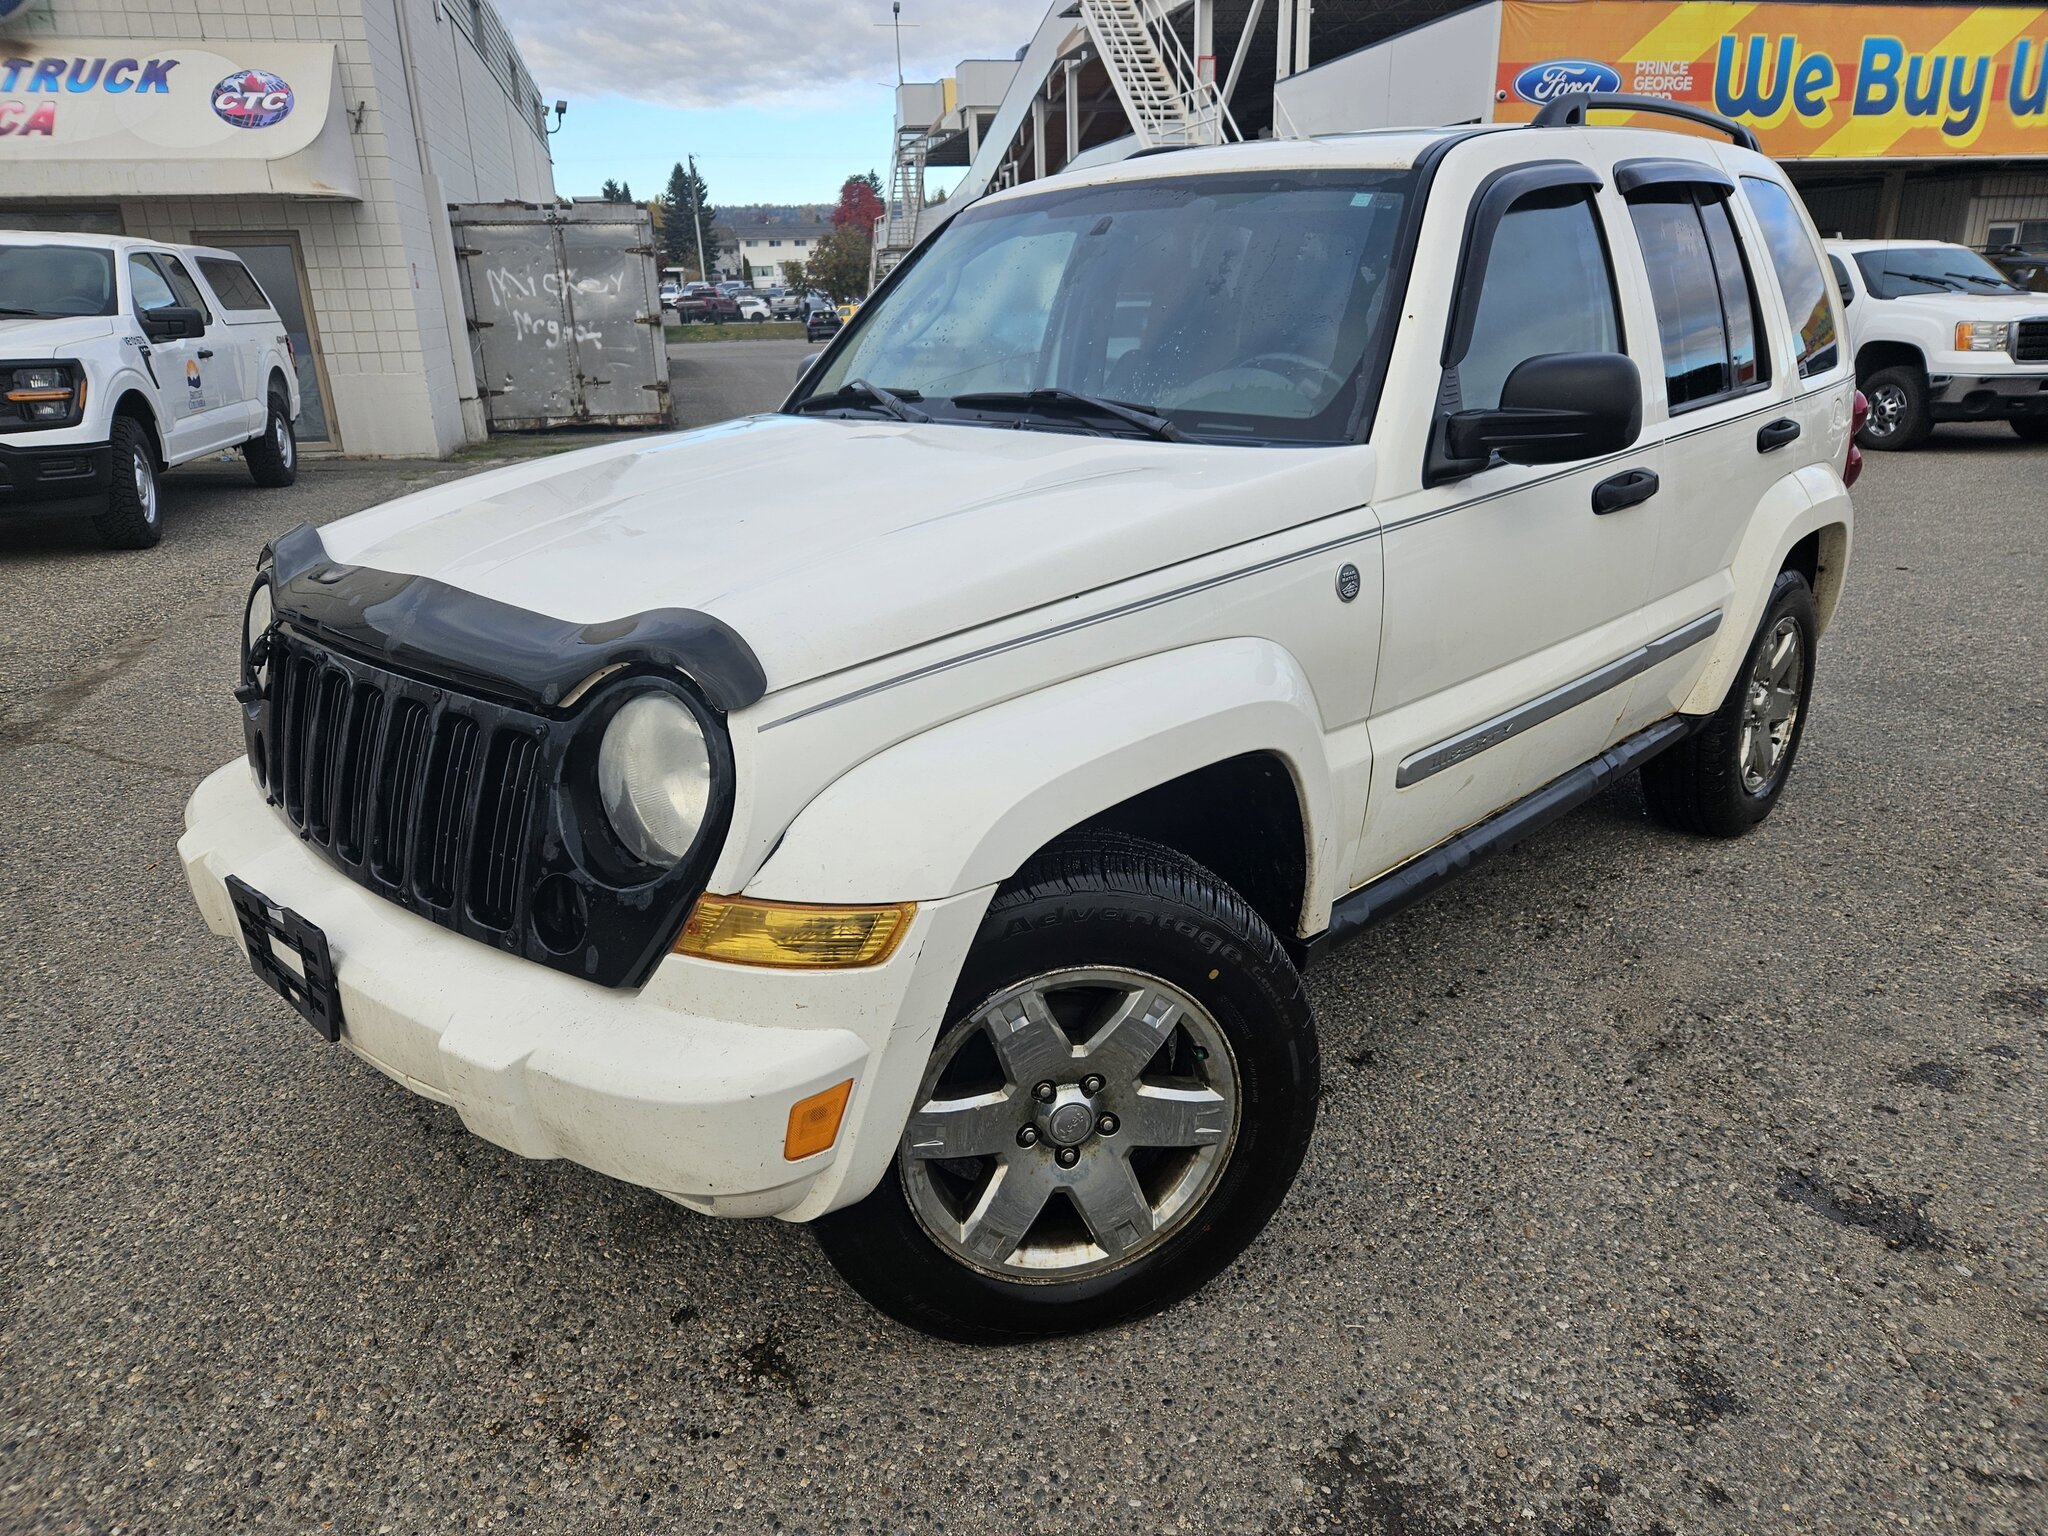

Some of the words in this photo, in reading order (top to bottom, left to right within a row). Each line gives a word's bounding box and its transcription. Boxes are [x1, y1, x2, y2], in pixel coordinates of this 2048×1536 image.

[1, 57, 180, 94] TRUCK
[1534, 66, 1602, 99] Ford
[1633, 76, 1694, 91] GEORGE
[1635, 60, 1690, 75] PRINCE
[214, 91, 288, 110] CTC
[1713, 34, 1835, 118] We
[1853, 36, 1992, 137] Buy
[0, 100, 57, 136] CA
